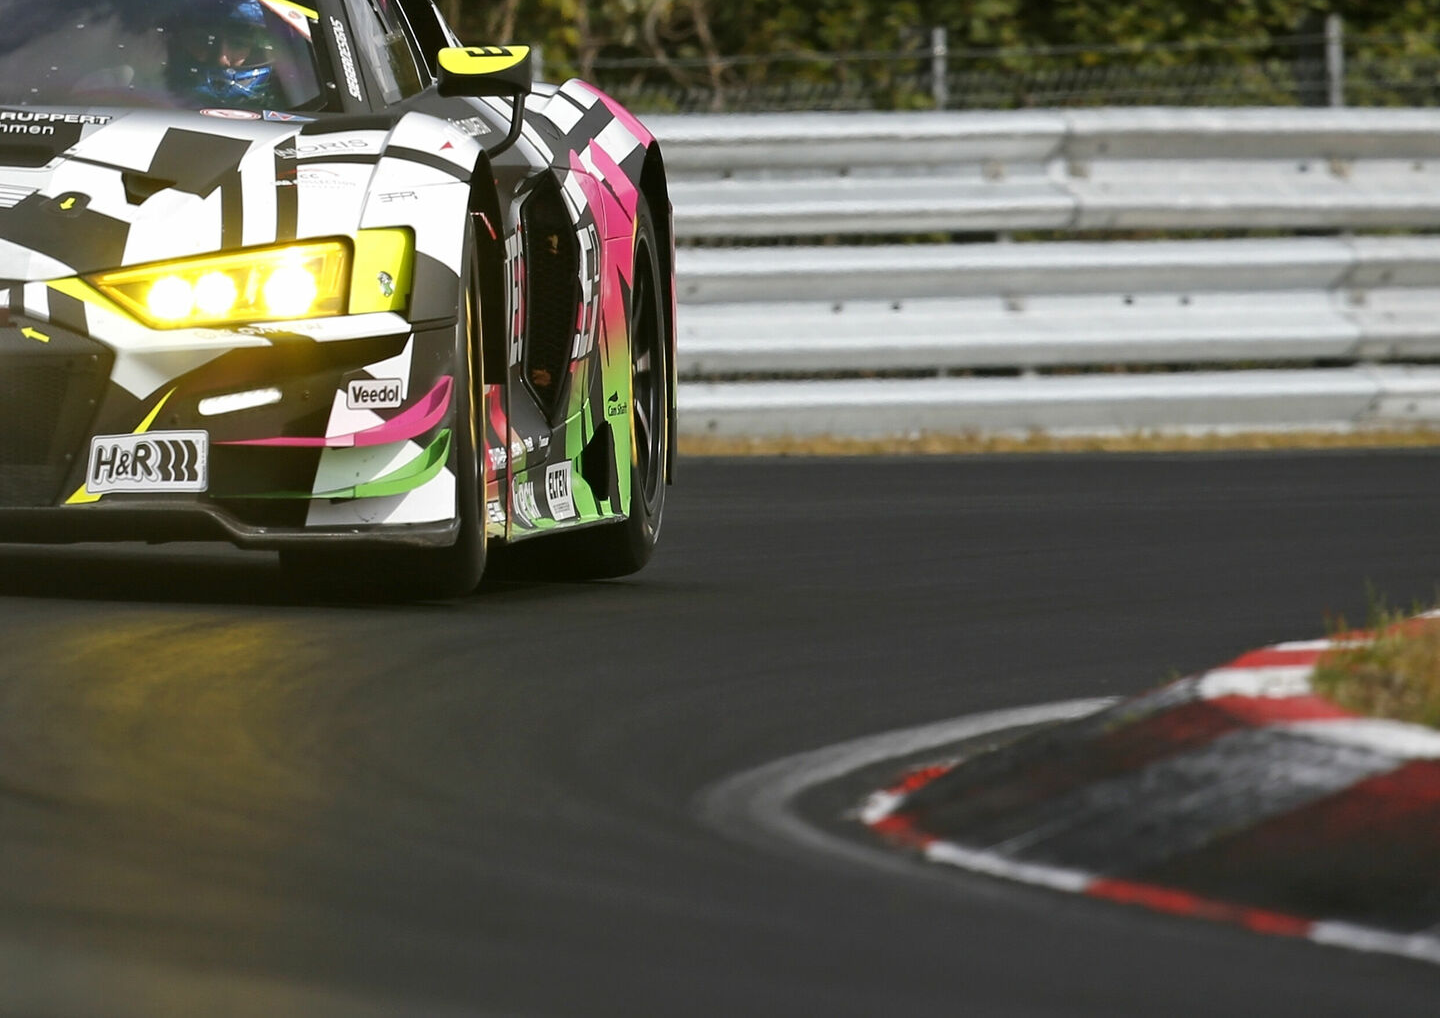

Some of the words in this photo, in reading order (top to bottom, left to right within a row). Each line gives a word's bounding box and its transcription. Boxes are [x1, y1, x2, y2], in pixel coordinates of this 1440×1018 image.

[0, 112, 113, 125] RUPPERT
[351, 385, 400, 404] Veedol
[93, 442, 154, 481] H&R
